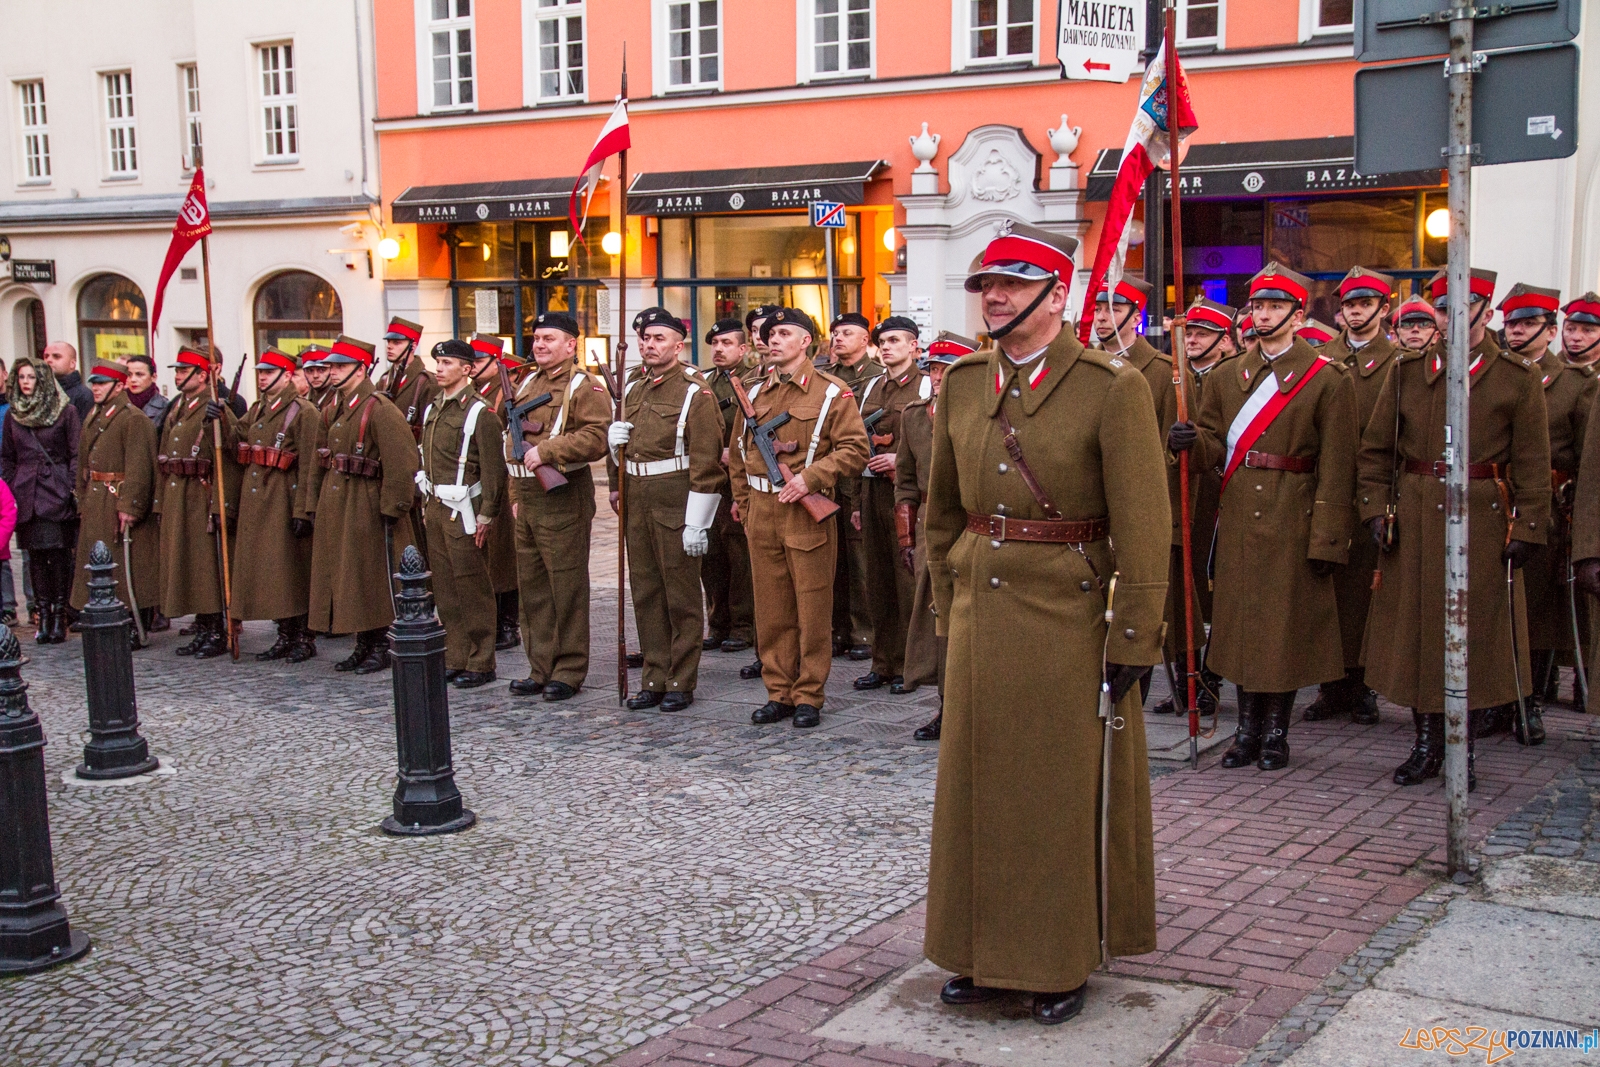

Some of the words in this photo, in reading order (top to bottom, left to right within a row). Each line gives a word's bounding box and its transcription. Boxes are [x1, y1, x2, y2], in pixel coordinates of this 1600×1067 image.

[1067, 0, 1134, 32] MAKIETA
[1063, 28, 1099, 47] DAWNEGO
[1101, 32, 1137, 51] POZNANIA
[1307, 169, 1377, 181] BAZA
[771, 188, 822, 201] BAZAR
[509, 201, 551, 212] BAZAR
[656, 196, 703, 208] BAZAR
[418, 206, 457, 216] BAZAR
[816, 204, 845, 226] TAXI
